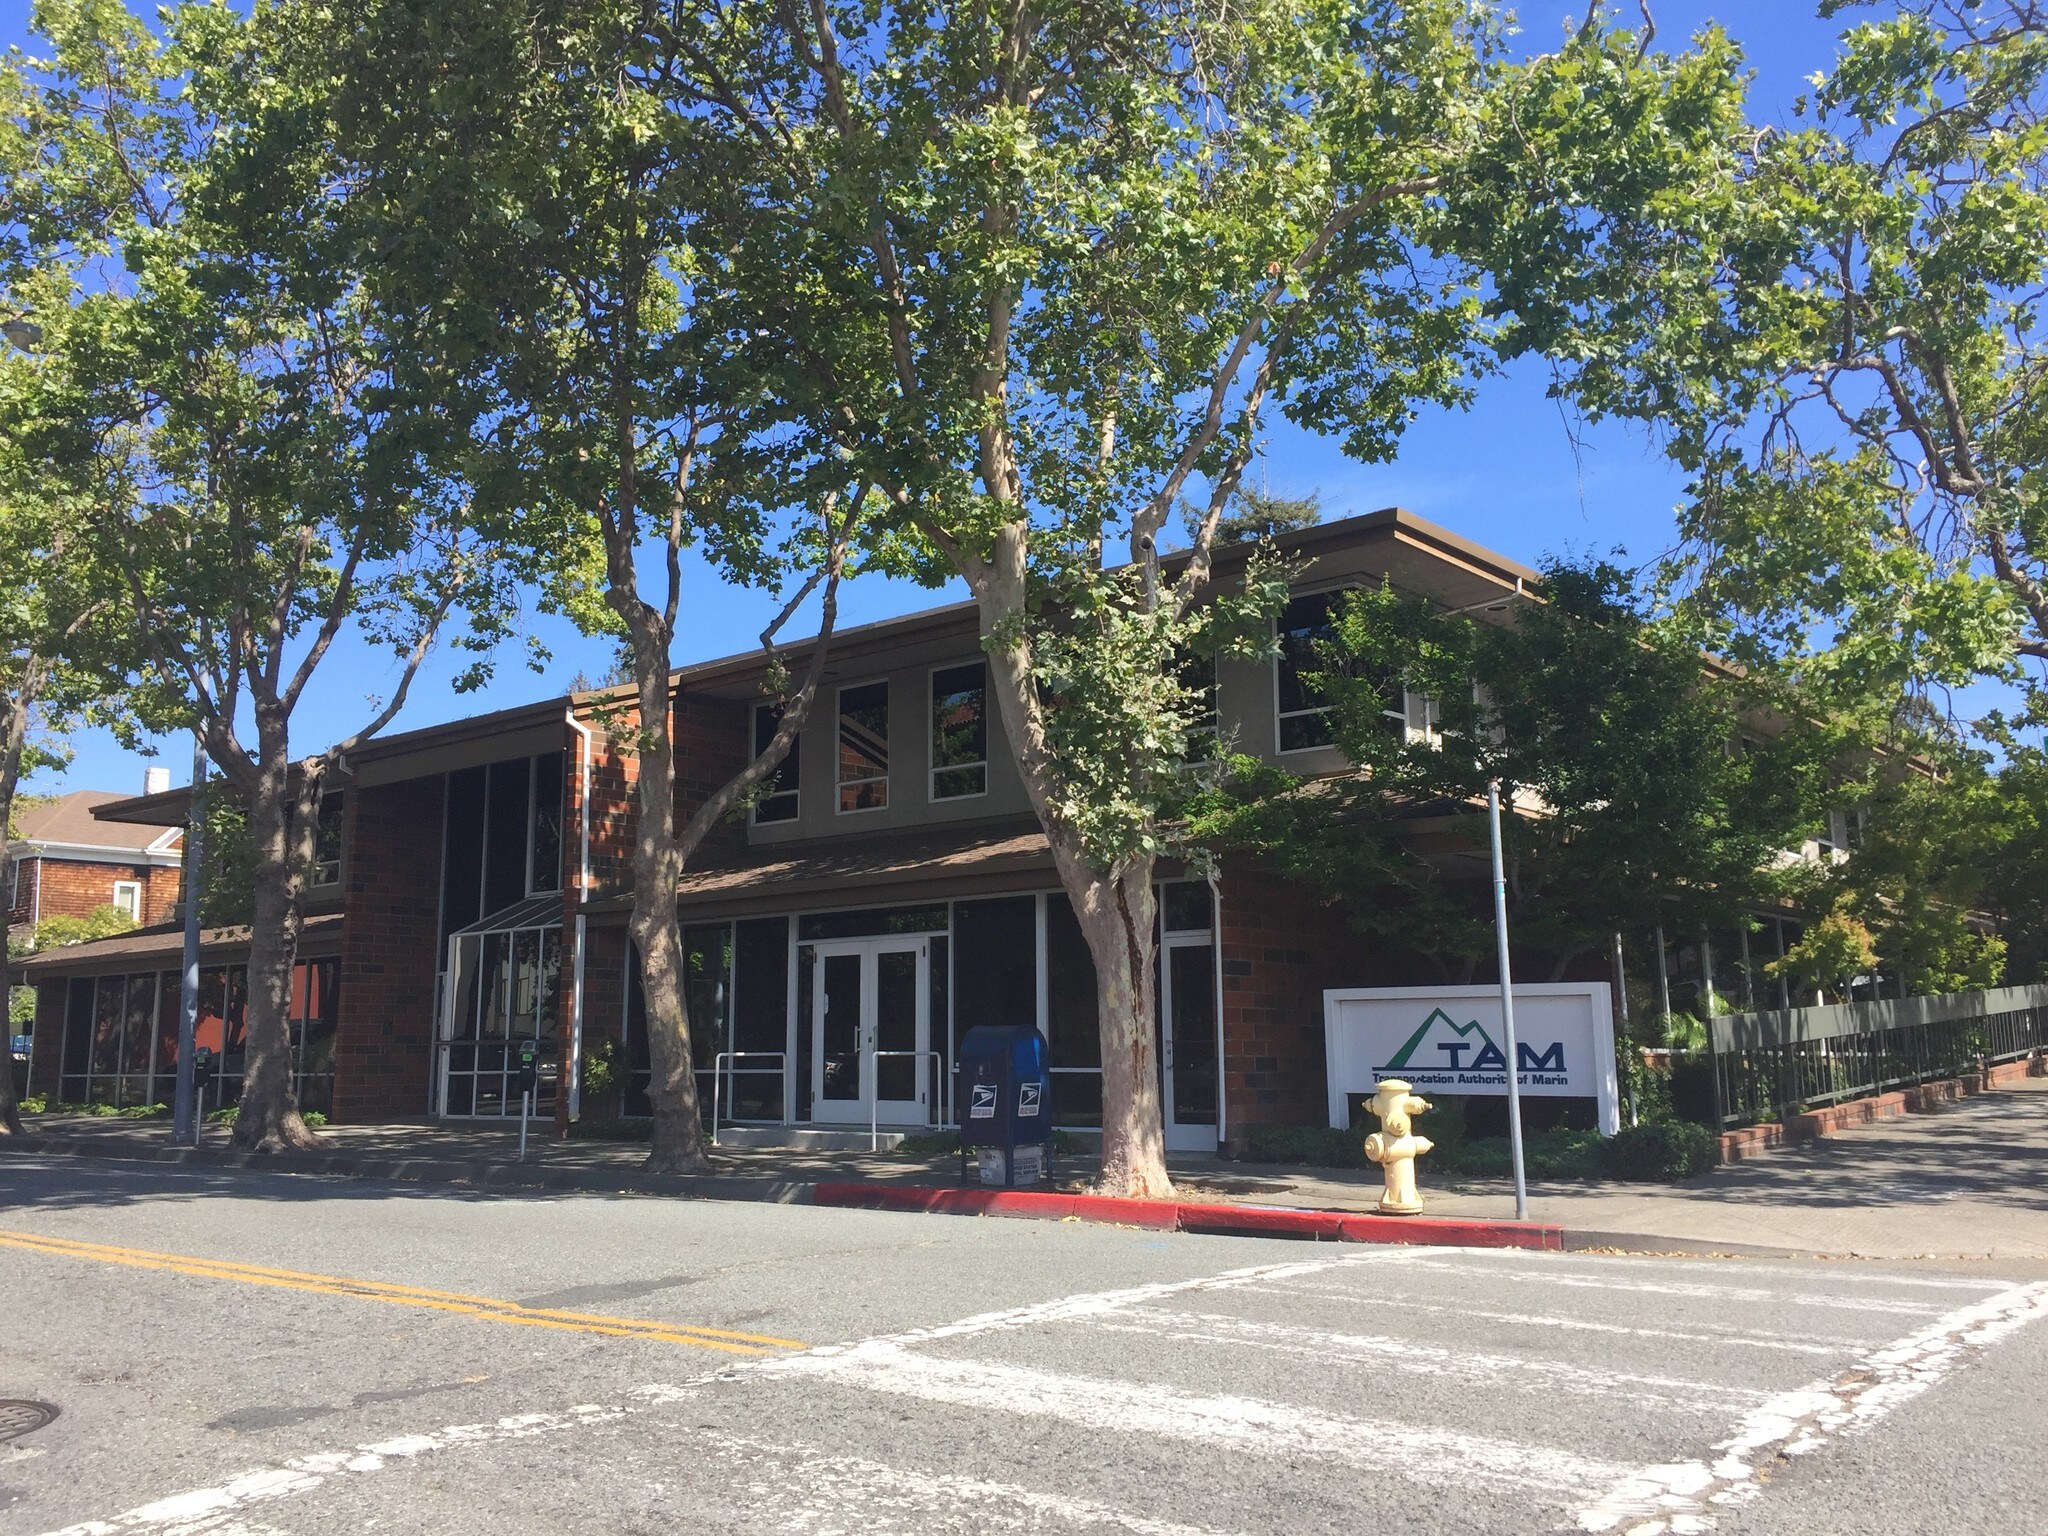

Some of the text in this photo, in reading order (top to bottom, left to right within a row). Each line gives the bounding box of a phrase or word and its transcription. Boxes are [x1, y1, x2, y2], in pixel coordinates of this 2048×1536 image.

[1437, 1042, 1565, 1070] TAM
[1458, 1073, 1508, 1084] Authorit
[1517, 1074, 1528, 1084] of
[1532, 1074, 1568, 1085] Marin
